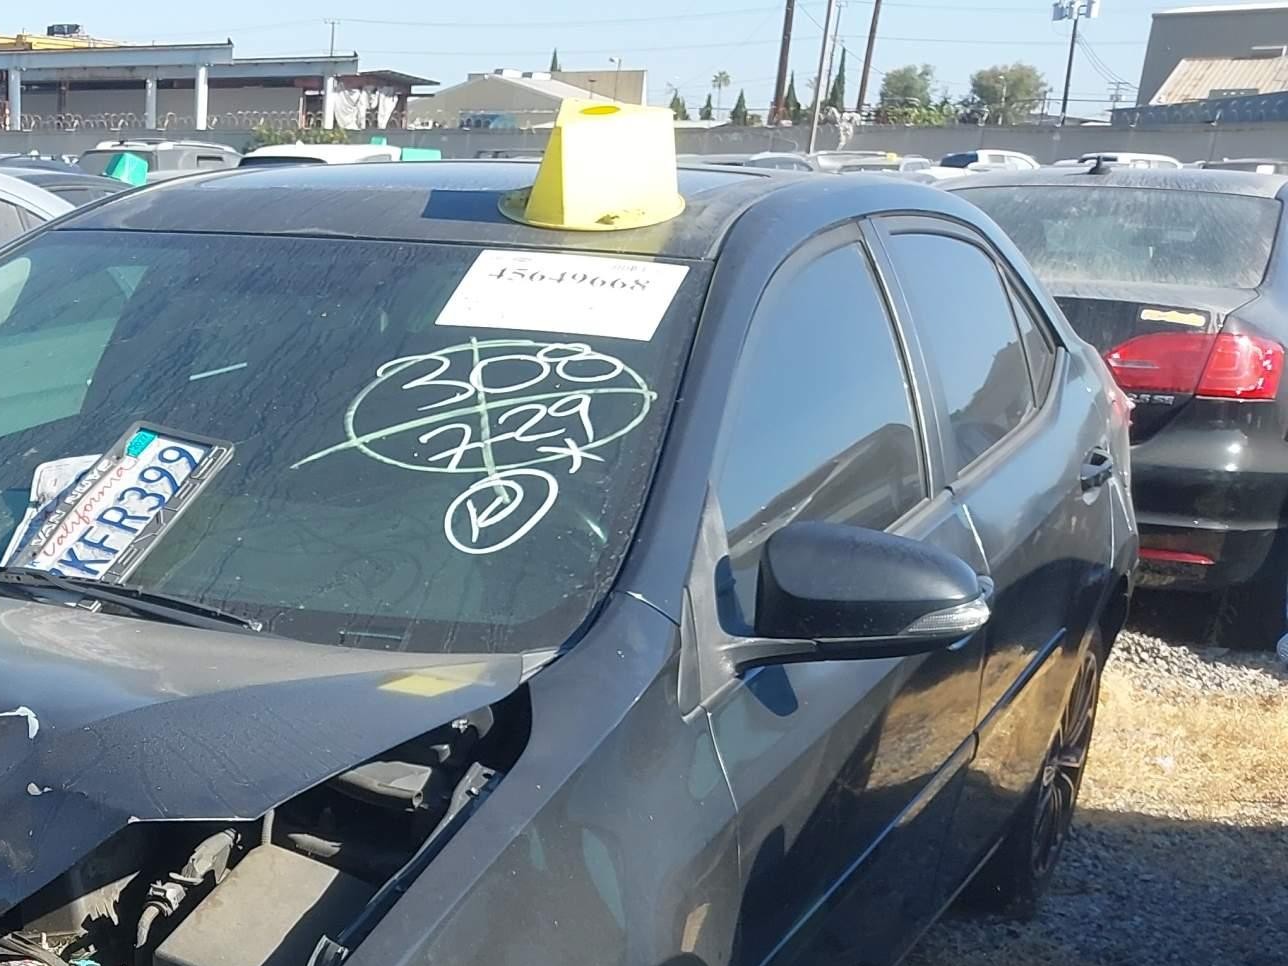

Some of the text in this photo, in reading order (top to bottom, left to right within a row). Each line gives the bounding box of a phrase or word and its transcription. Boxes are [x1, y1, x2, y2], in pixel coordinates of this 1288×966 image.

[377, 343, 624, 411] 308
[30, 510, 67, 548] VAN
[42, 461, 134, 557] California
[104, 447, 227, 581] EYES
